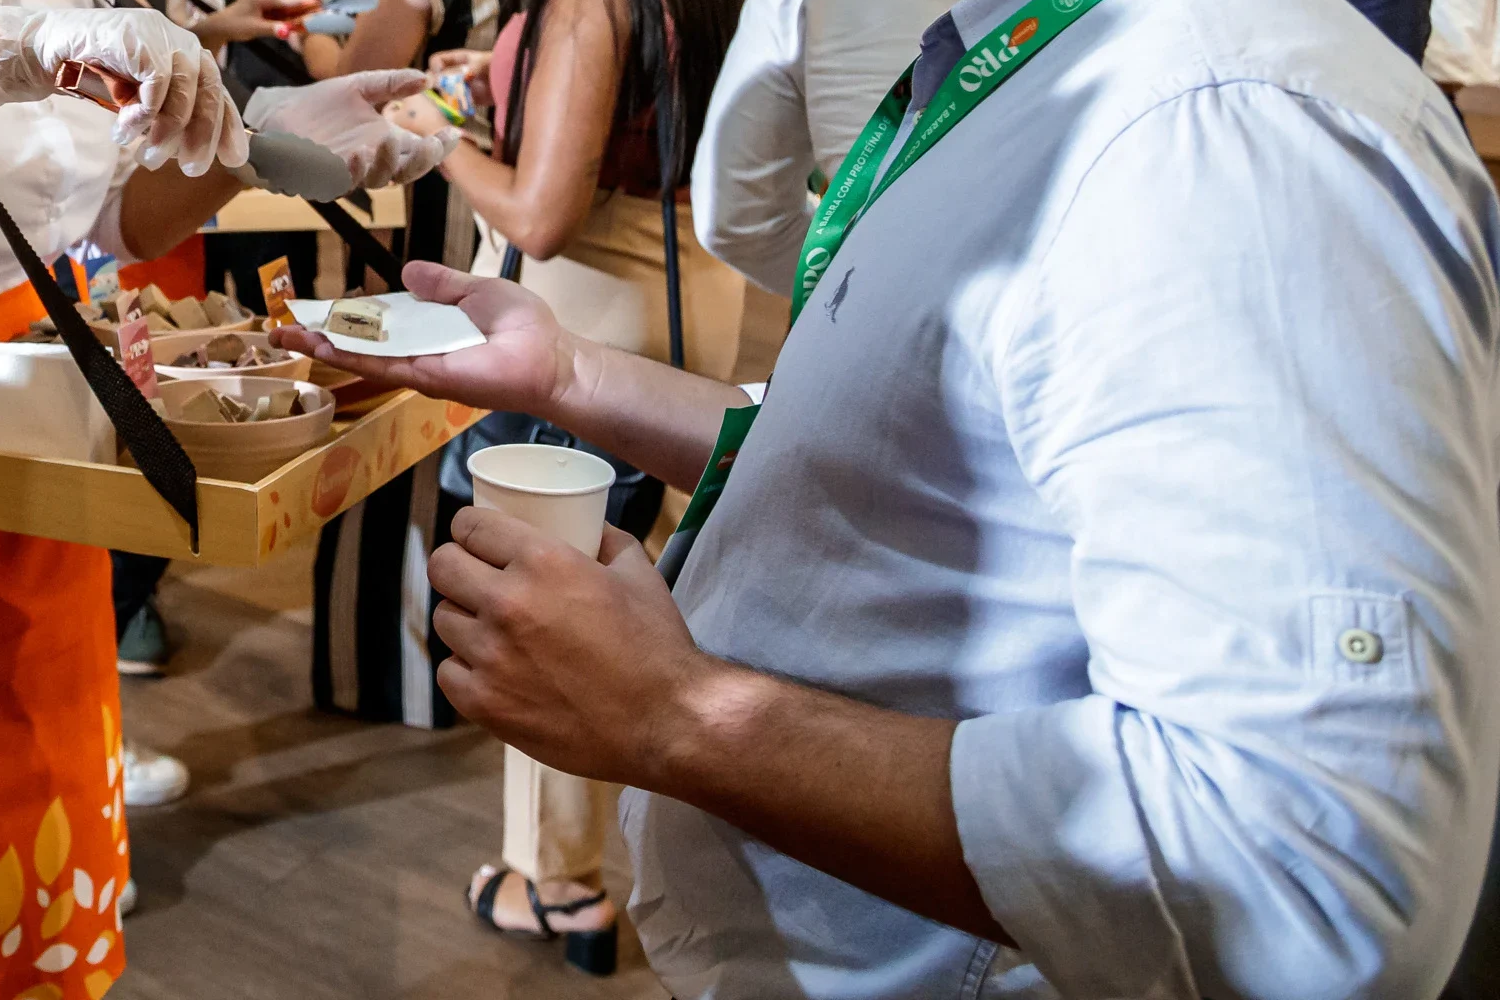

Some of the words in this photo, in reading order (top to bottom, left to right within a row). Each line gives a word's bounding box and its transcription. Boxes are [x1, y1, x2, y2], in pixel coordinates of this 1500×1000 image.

[959, 33, 1020, 92] PRO
[948, 102, 957, 112] A
[879, 115, 893, 132] DE
[920, 109, 950, 141] BARRA
[849, 132, 883, 179] PROTEÍNA
[837, 180, 854, 199] COM
[819, 200, 841, 228] BARRA
[816, 226, 823, 235] A
